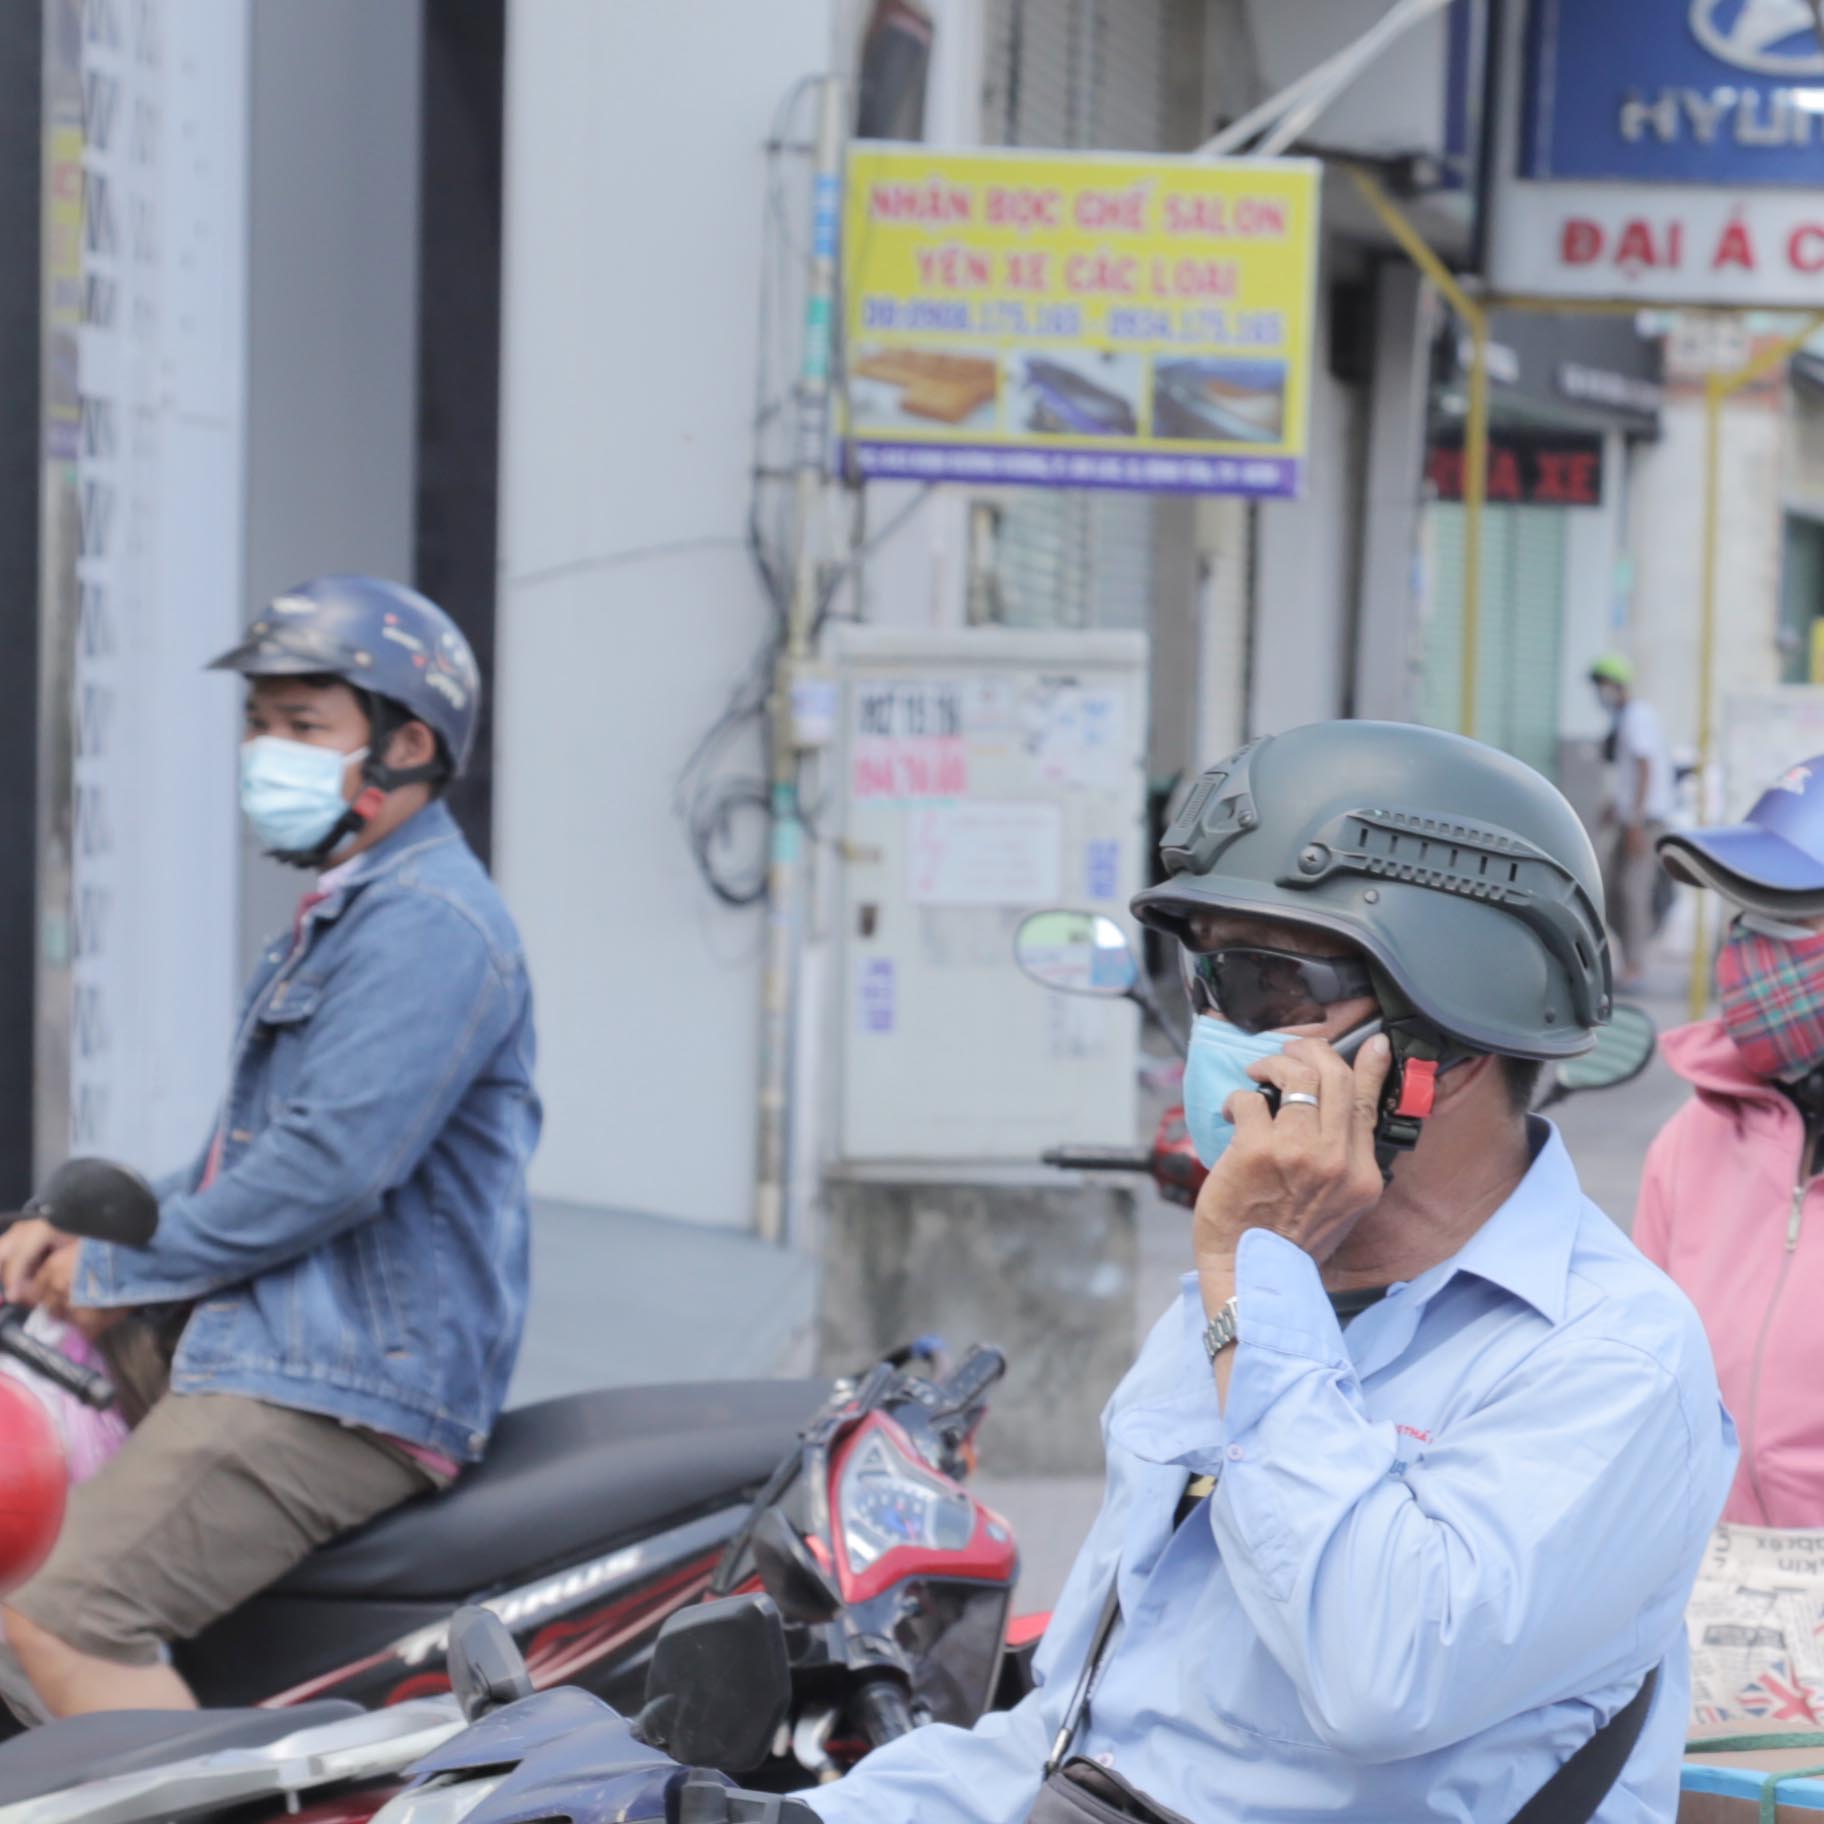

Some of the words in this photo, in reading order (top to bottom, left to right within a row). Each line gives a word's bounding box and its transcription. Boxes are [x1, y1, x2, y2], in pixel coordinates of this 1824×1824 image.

[1164, 195, 1286, 236] SALON
[1560, 217, 1685, 280] ĐẠI
[1005, 252, 1050, 292] XE
